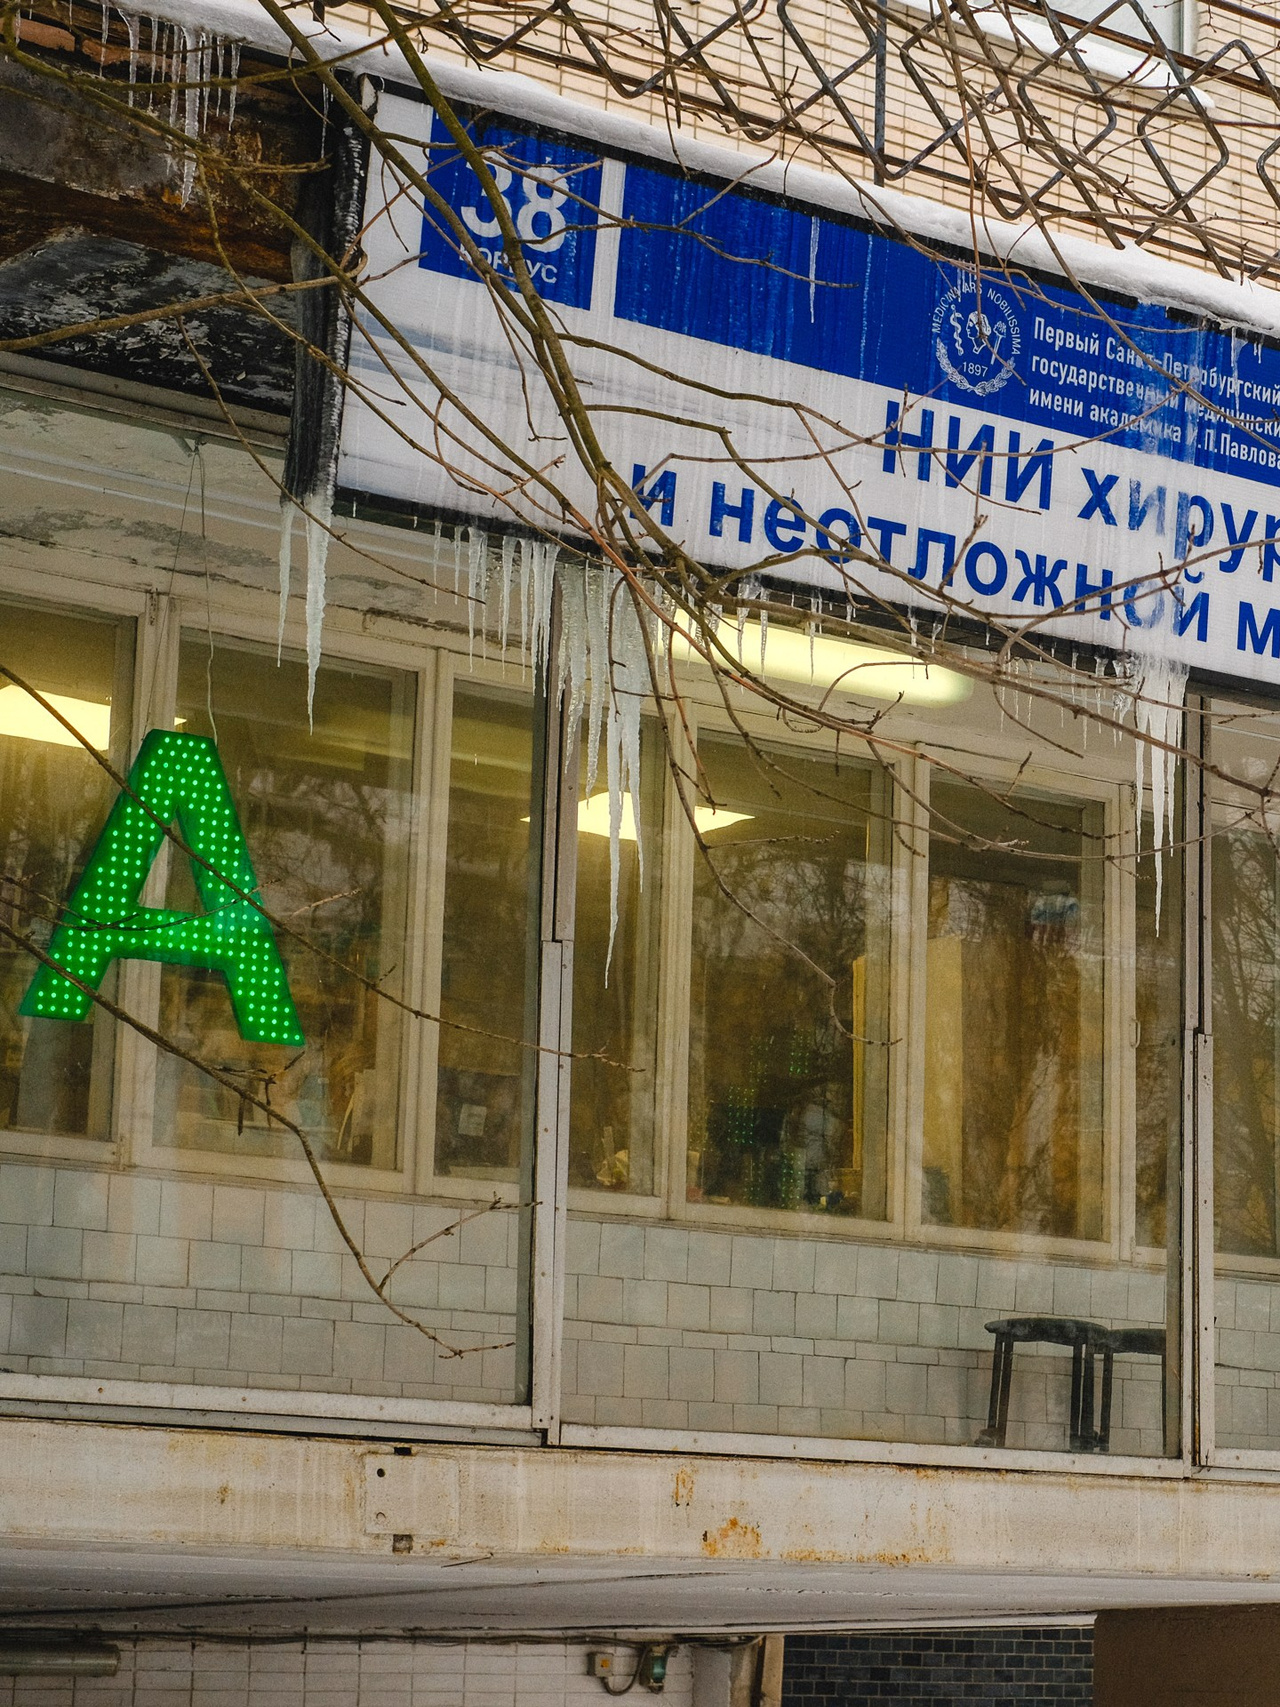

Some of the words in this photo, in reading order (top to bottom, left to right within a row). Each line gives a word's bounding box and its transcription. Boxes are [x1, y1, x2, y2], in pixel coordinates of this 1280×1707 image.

[461, 151, 569, 253] 38
[459, 244, 557, 283] КОРУС
[932, 286, 961, 333] MEDICINA
[987, 288, 1021, 355] NOBILISSIMA
[962, 362, 988, 377] 1897
[1034, 316, 1099, 356] Первый
[1106, 337, 1280, 406] Сант-Петрбургский
[1029, 388, 1083, 417] имени
[882, 400, 1054, 510] НИИ
[630, 463, 676, 527] и
[710, 482, 1209, 642] неотложной
